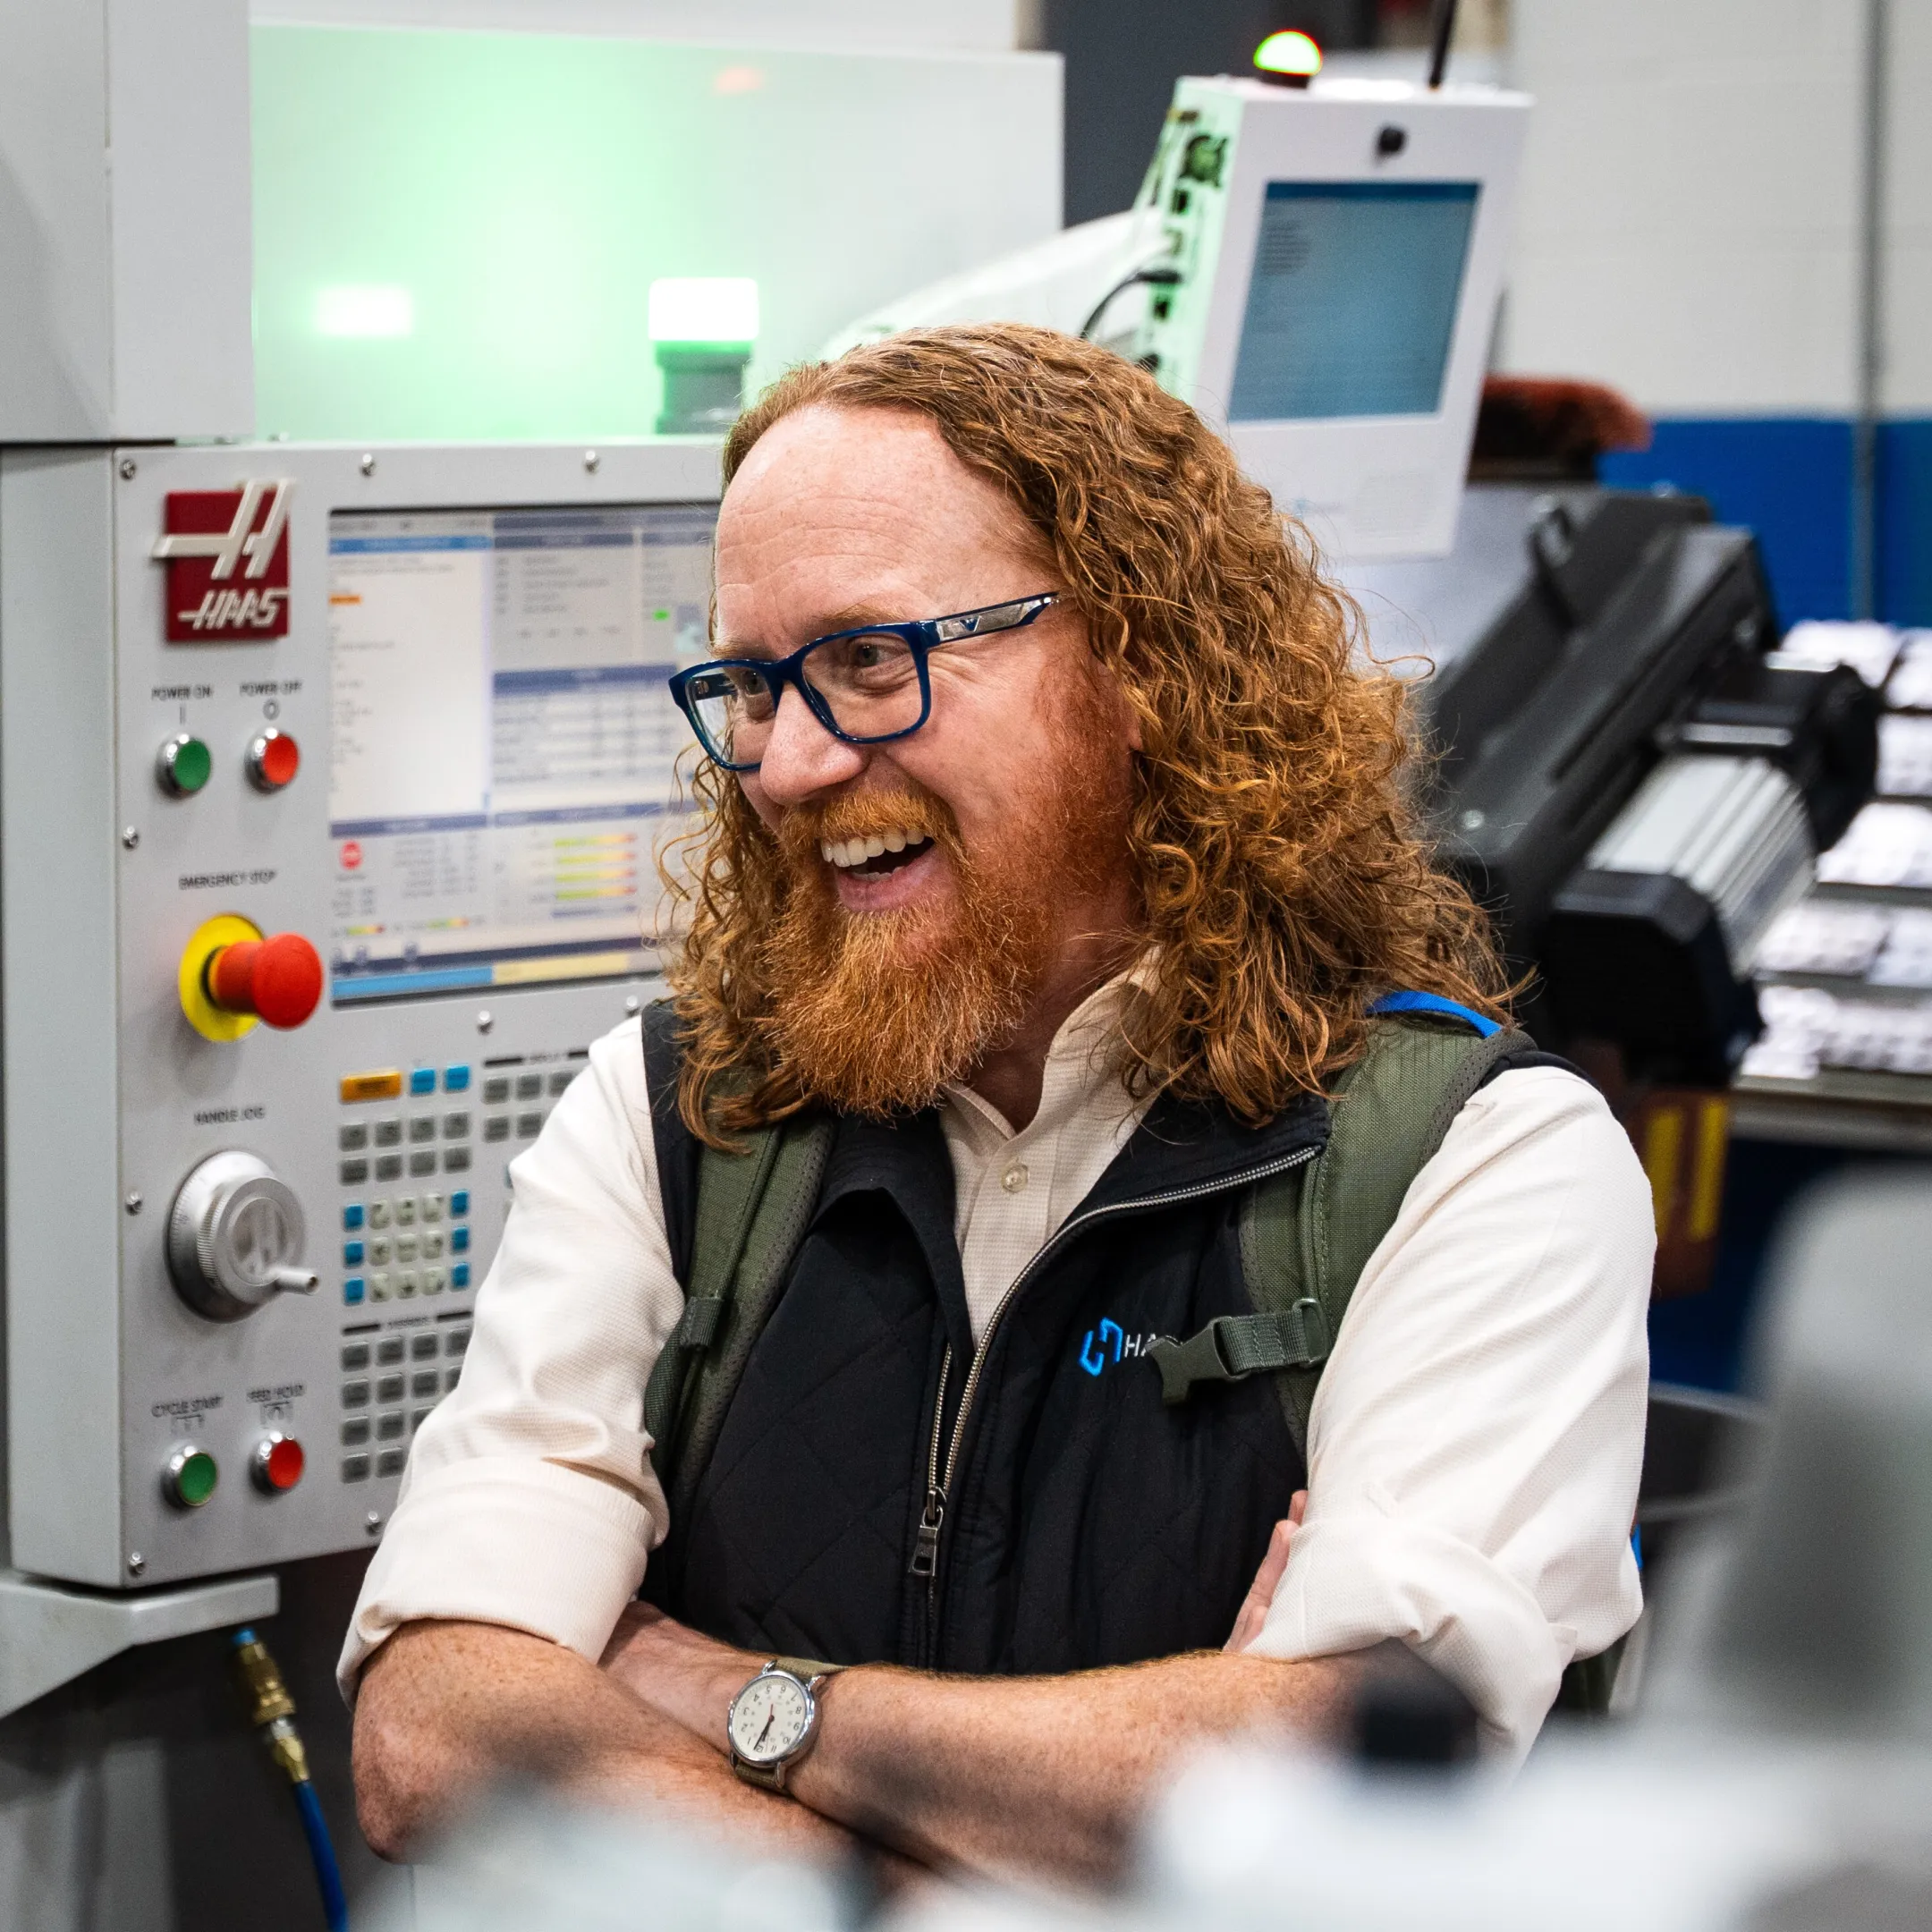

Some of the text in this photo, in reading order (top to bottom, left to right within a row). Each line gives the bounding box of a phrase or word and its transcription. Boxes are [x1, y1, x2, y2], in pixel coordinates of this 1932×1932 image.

[178, 589, 290, 630] HAAS
[150, 682, 213, 701] POWER ON
[239, 679, 302, 698] POWER OFF
[178, 871, 246, 891] EMERGENCY
[193, 1108, 239, 1126] HANDLE
